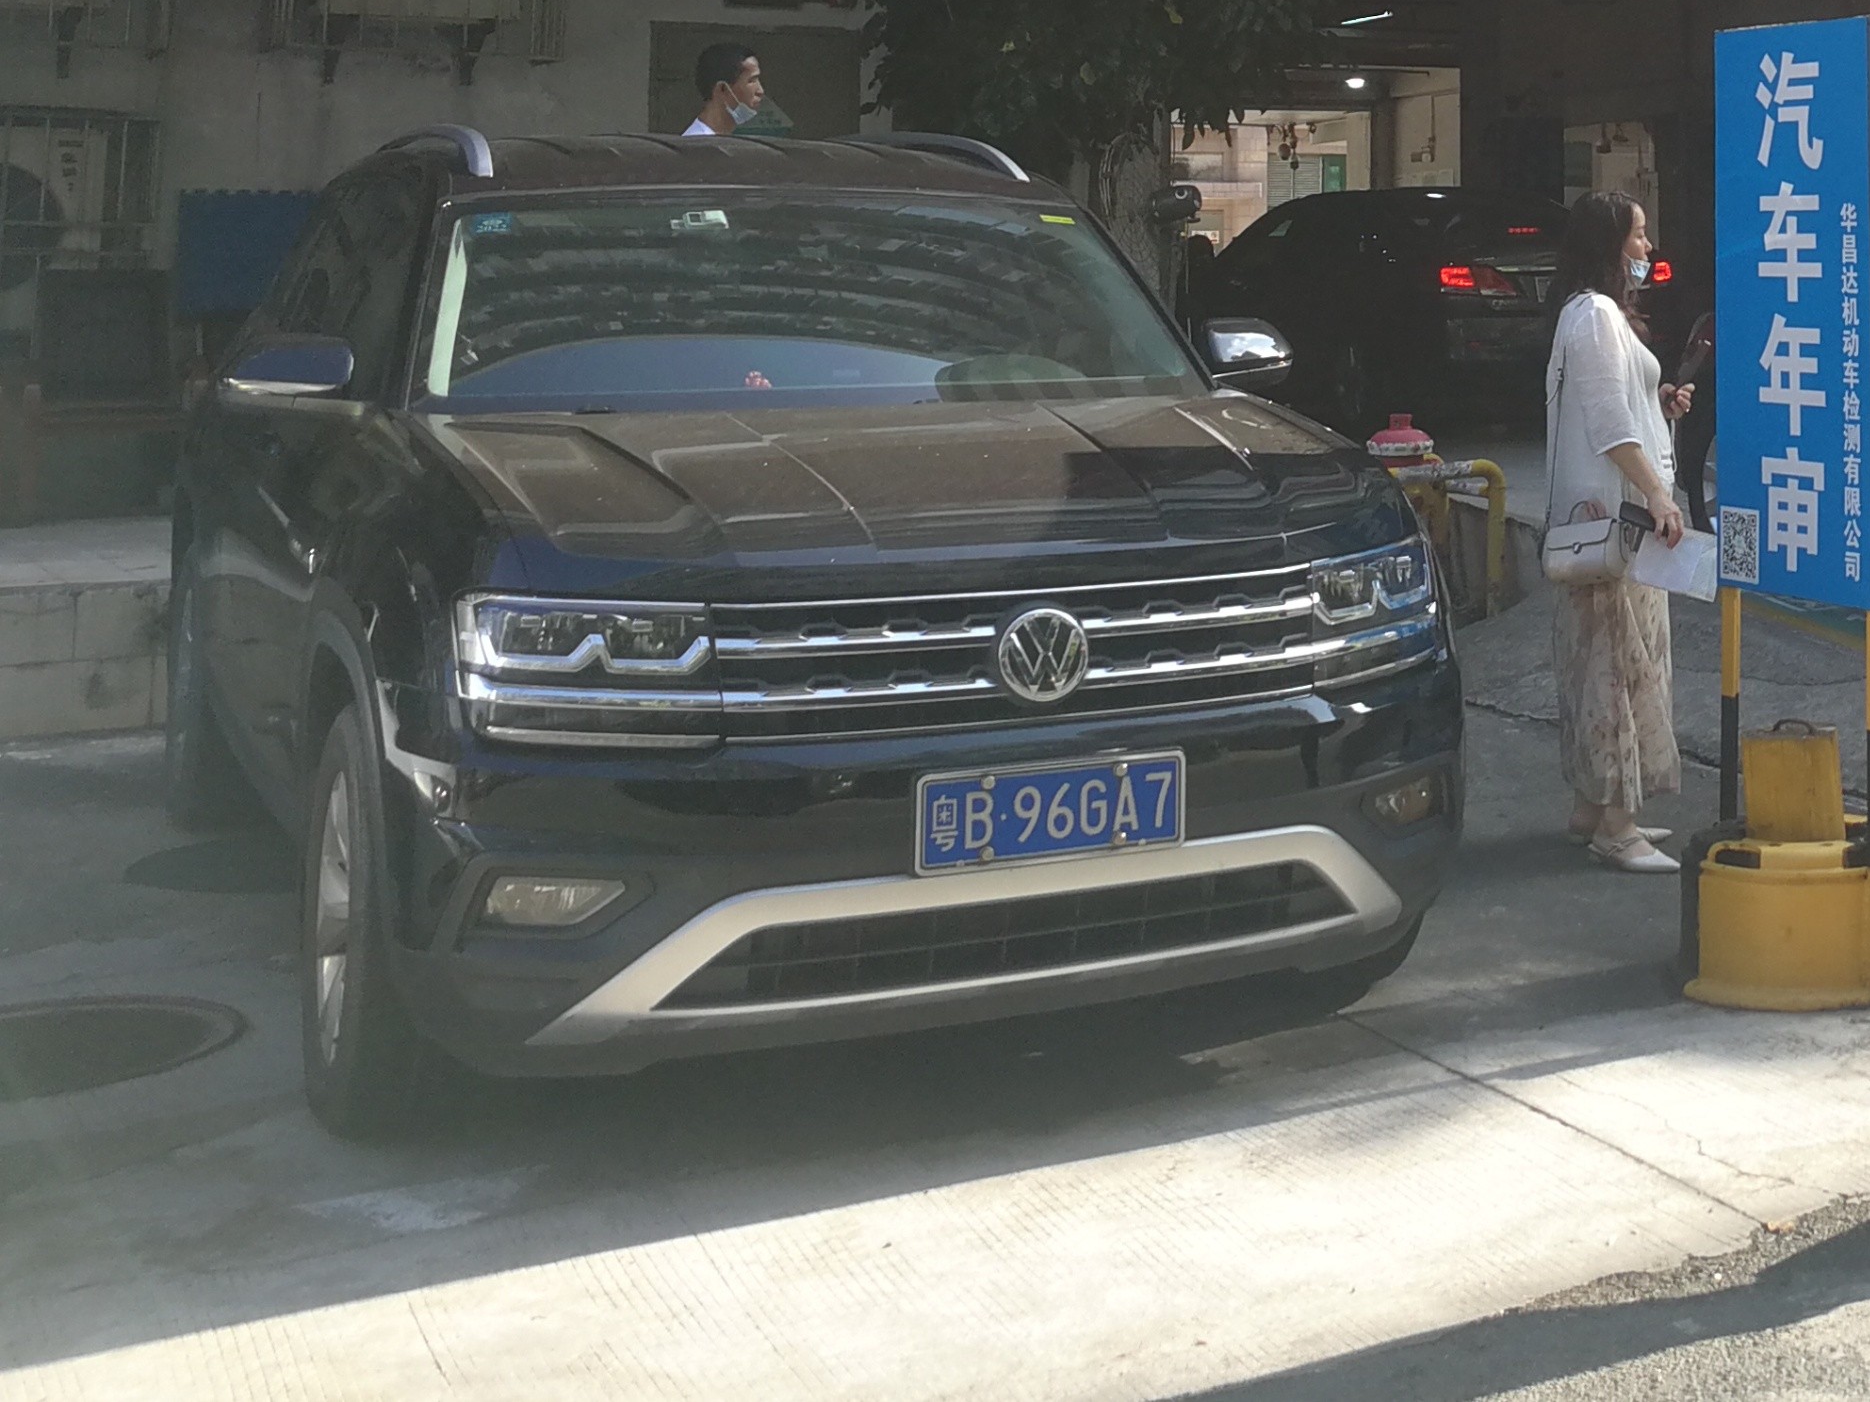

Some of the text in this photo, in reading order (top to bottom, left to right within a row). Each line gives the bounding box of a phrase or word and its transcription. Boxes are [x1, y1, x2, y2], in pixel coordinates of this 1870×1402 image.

[1755, 51, 1826, 573] 汽车年审
[1839, 202, 1862, 583] 华昌达机动车检测有限公司
